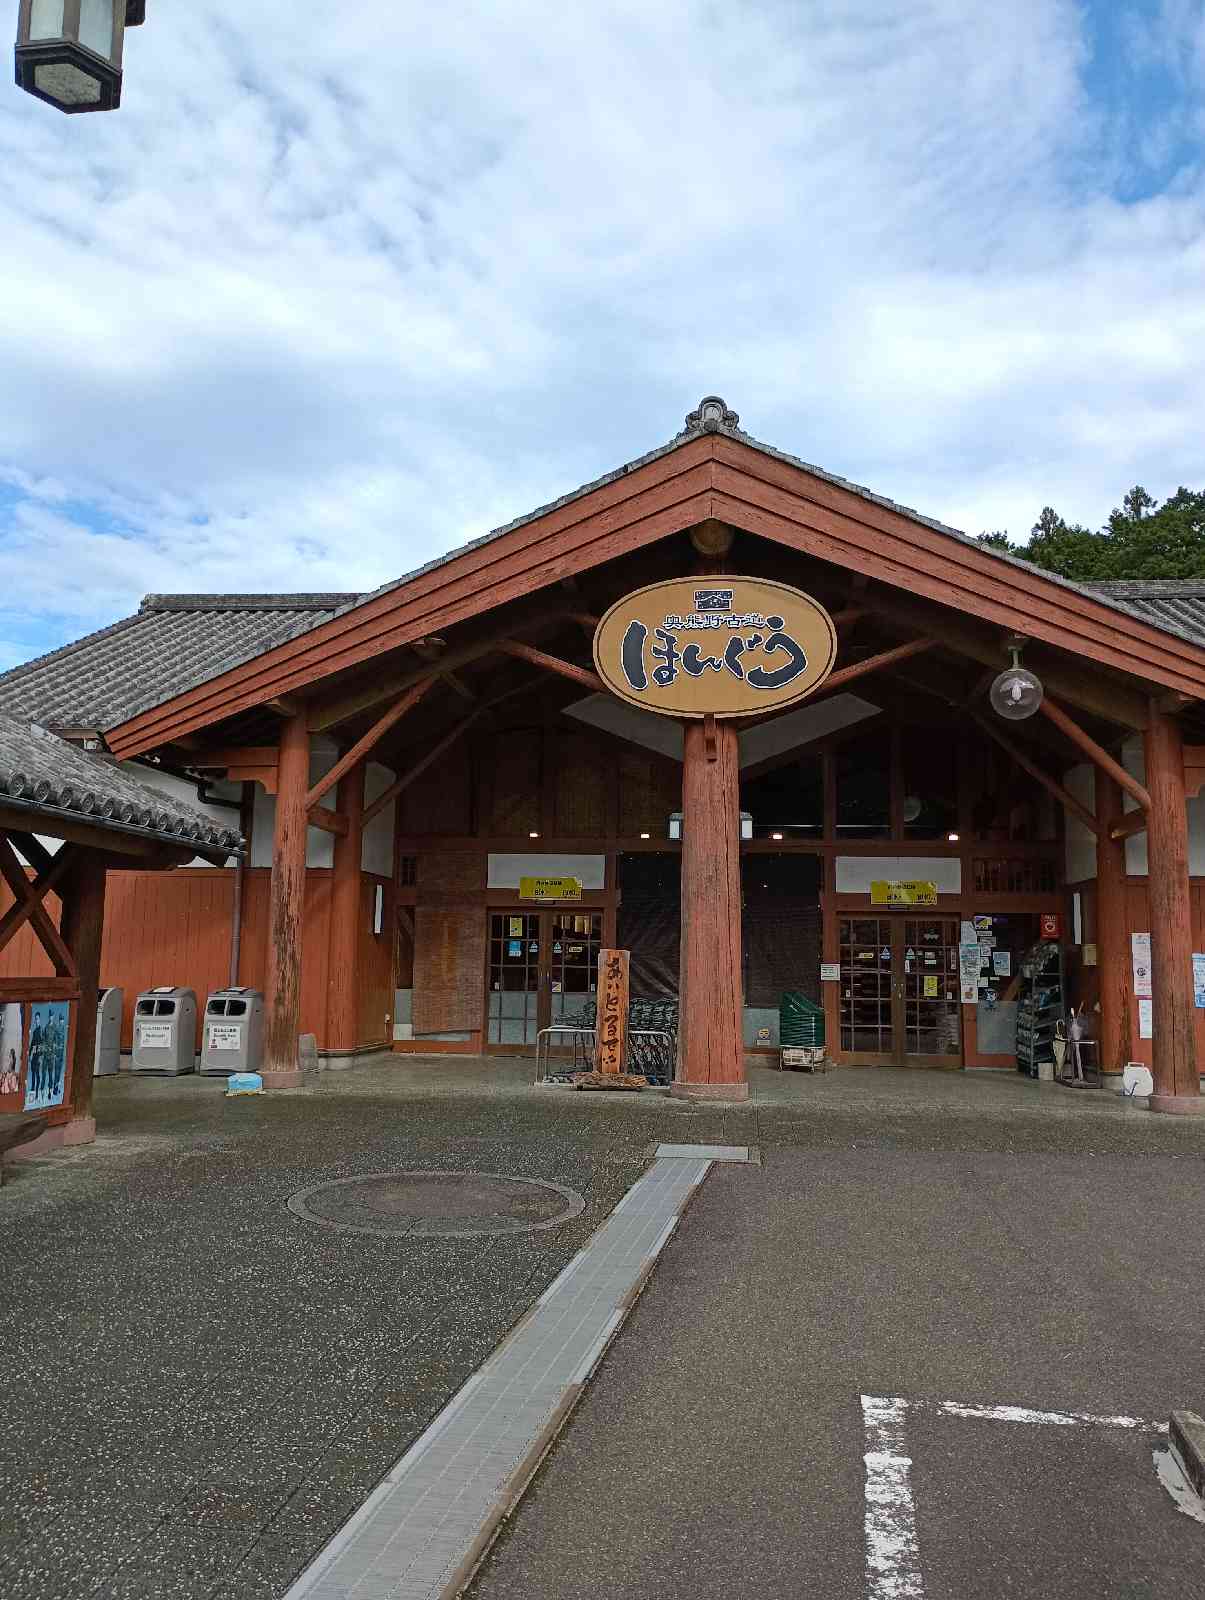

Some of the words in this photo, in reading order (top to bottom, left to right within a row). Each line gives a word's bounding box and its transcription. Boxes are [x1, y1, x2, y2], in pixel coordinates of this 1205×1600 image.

[663, 614, 766, 630] 奥熊野古道
[621, 617, 809, 690] ほんぐう
